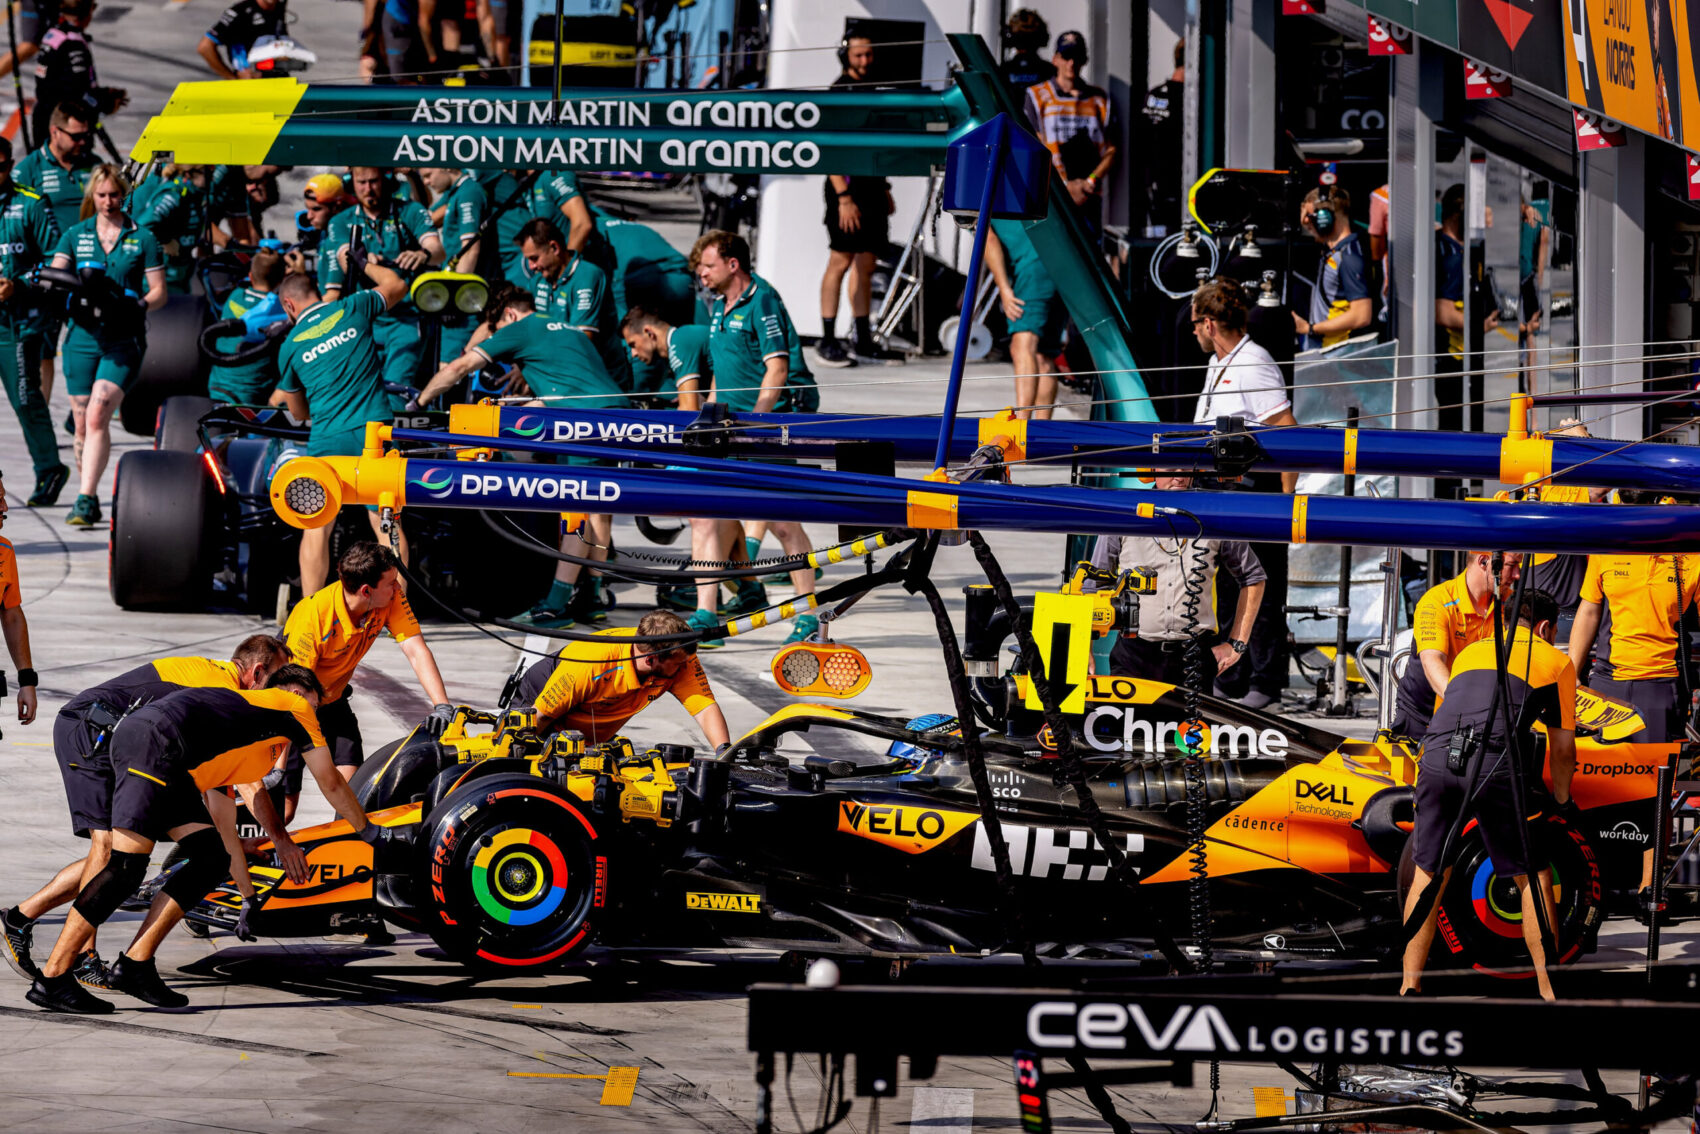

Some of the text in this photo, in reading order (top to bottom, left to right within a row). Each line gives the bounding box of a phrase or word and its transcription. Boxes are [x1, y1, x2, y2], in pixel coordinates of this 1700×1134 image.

[1606, 37, 1636, 91] NORRIS
[411, 97, 821, 129] ASTON MARTIN aramco
[393, 134, 821, 168] ASTON MARTIN aramco
[302, 327, 358, 363] aramco
[554, 420, 683, 444] DP WORL
[461, 474, 621, 502] DP WORLD
[1582, 762, 1655, 778] Dropbox
[1295, 779, 1354, 806] DELL
[841, 803, 945, 840] VELO
[1295, 801, 1353, 819] Technologies
[1600, 830, 1650, 844] workday
[431, 823, 456, 904] ZERO
[594, 855, 607, 908] PIRELLI
[1247, 1025, 1464, 1057] LOGISTICS
